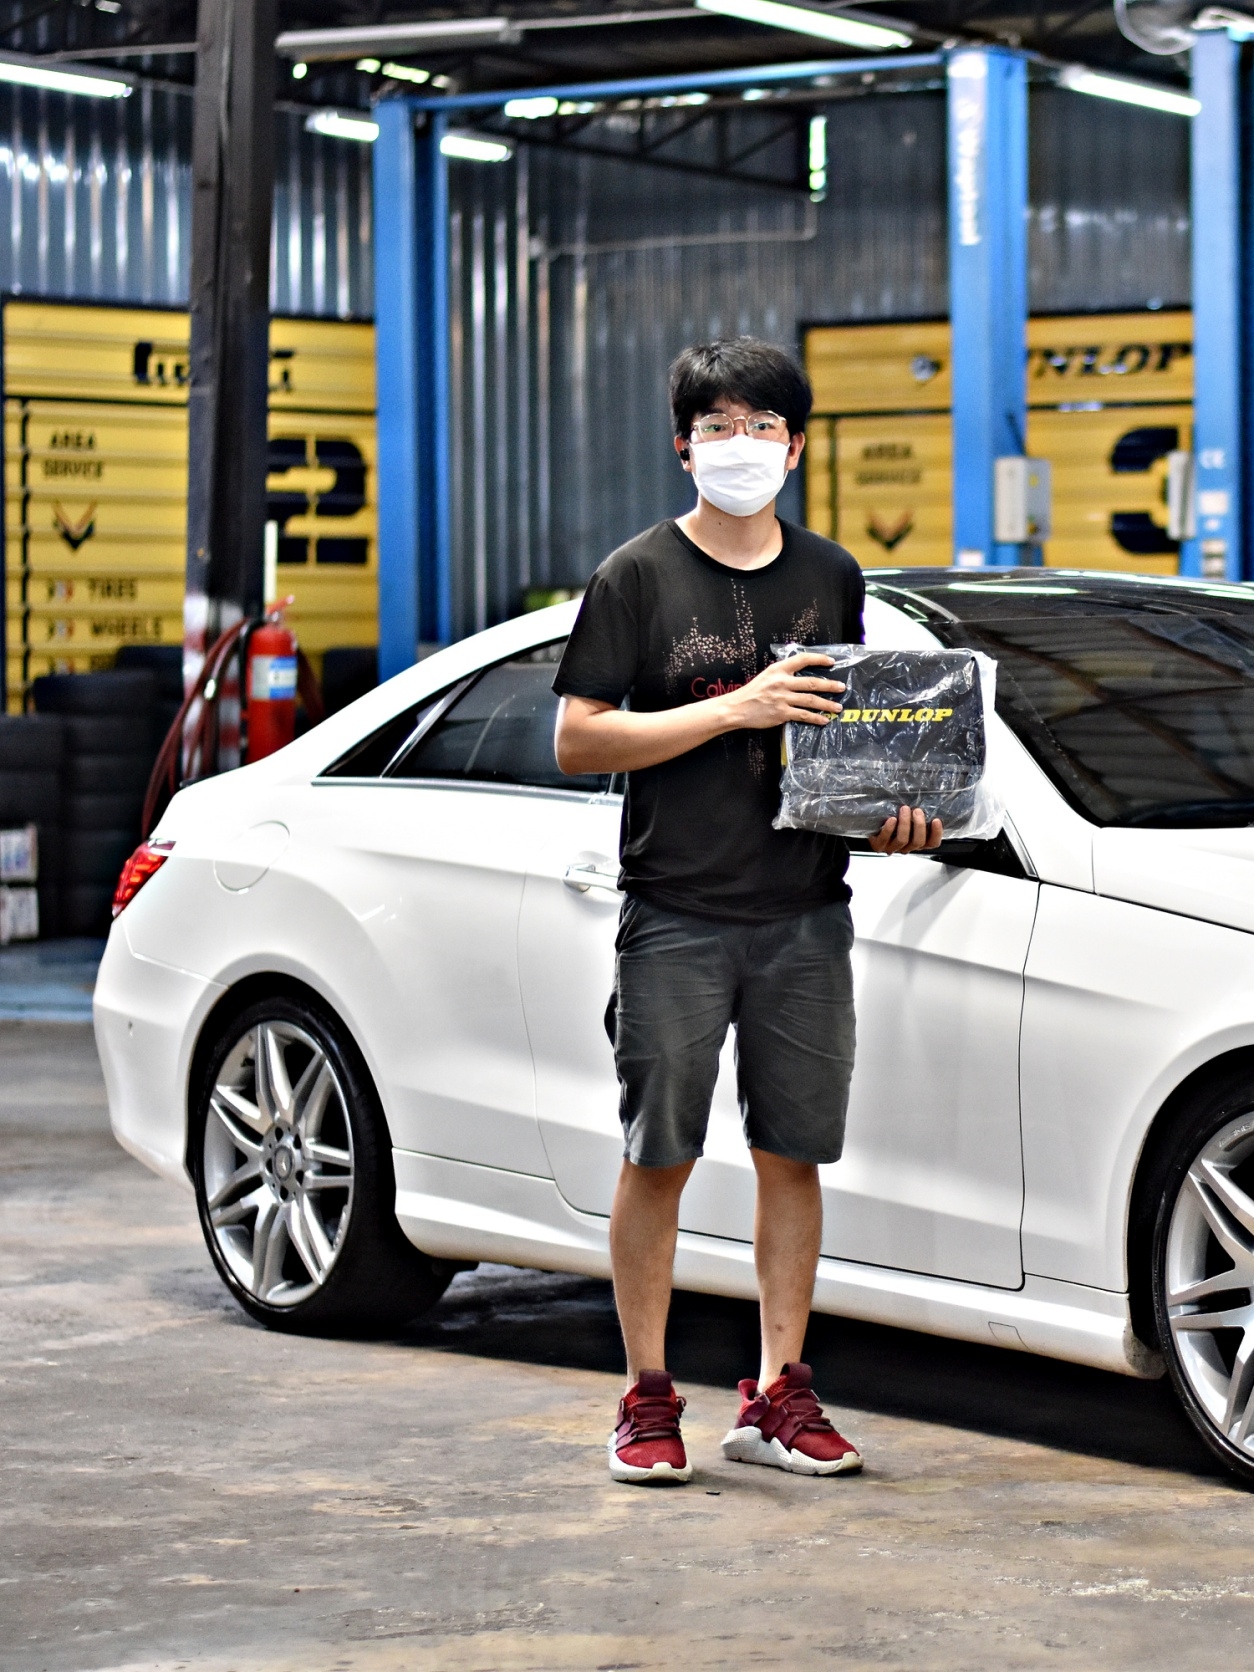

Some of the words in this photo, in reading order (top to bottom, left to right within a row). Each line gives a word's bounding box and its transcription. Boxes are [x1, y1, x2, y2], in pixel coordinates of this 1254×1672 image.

[49, 430, 97, 450] AREA
[88, 577, 138, 599] TIRES
[90, 617, 163, 638] WHEELS
[840, 707, 953, 723] DUNLOP
